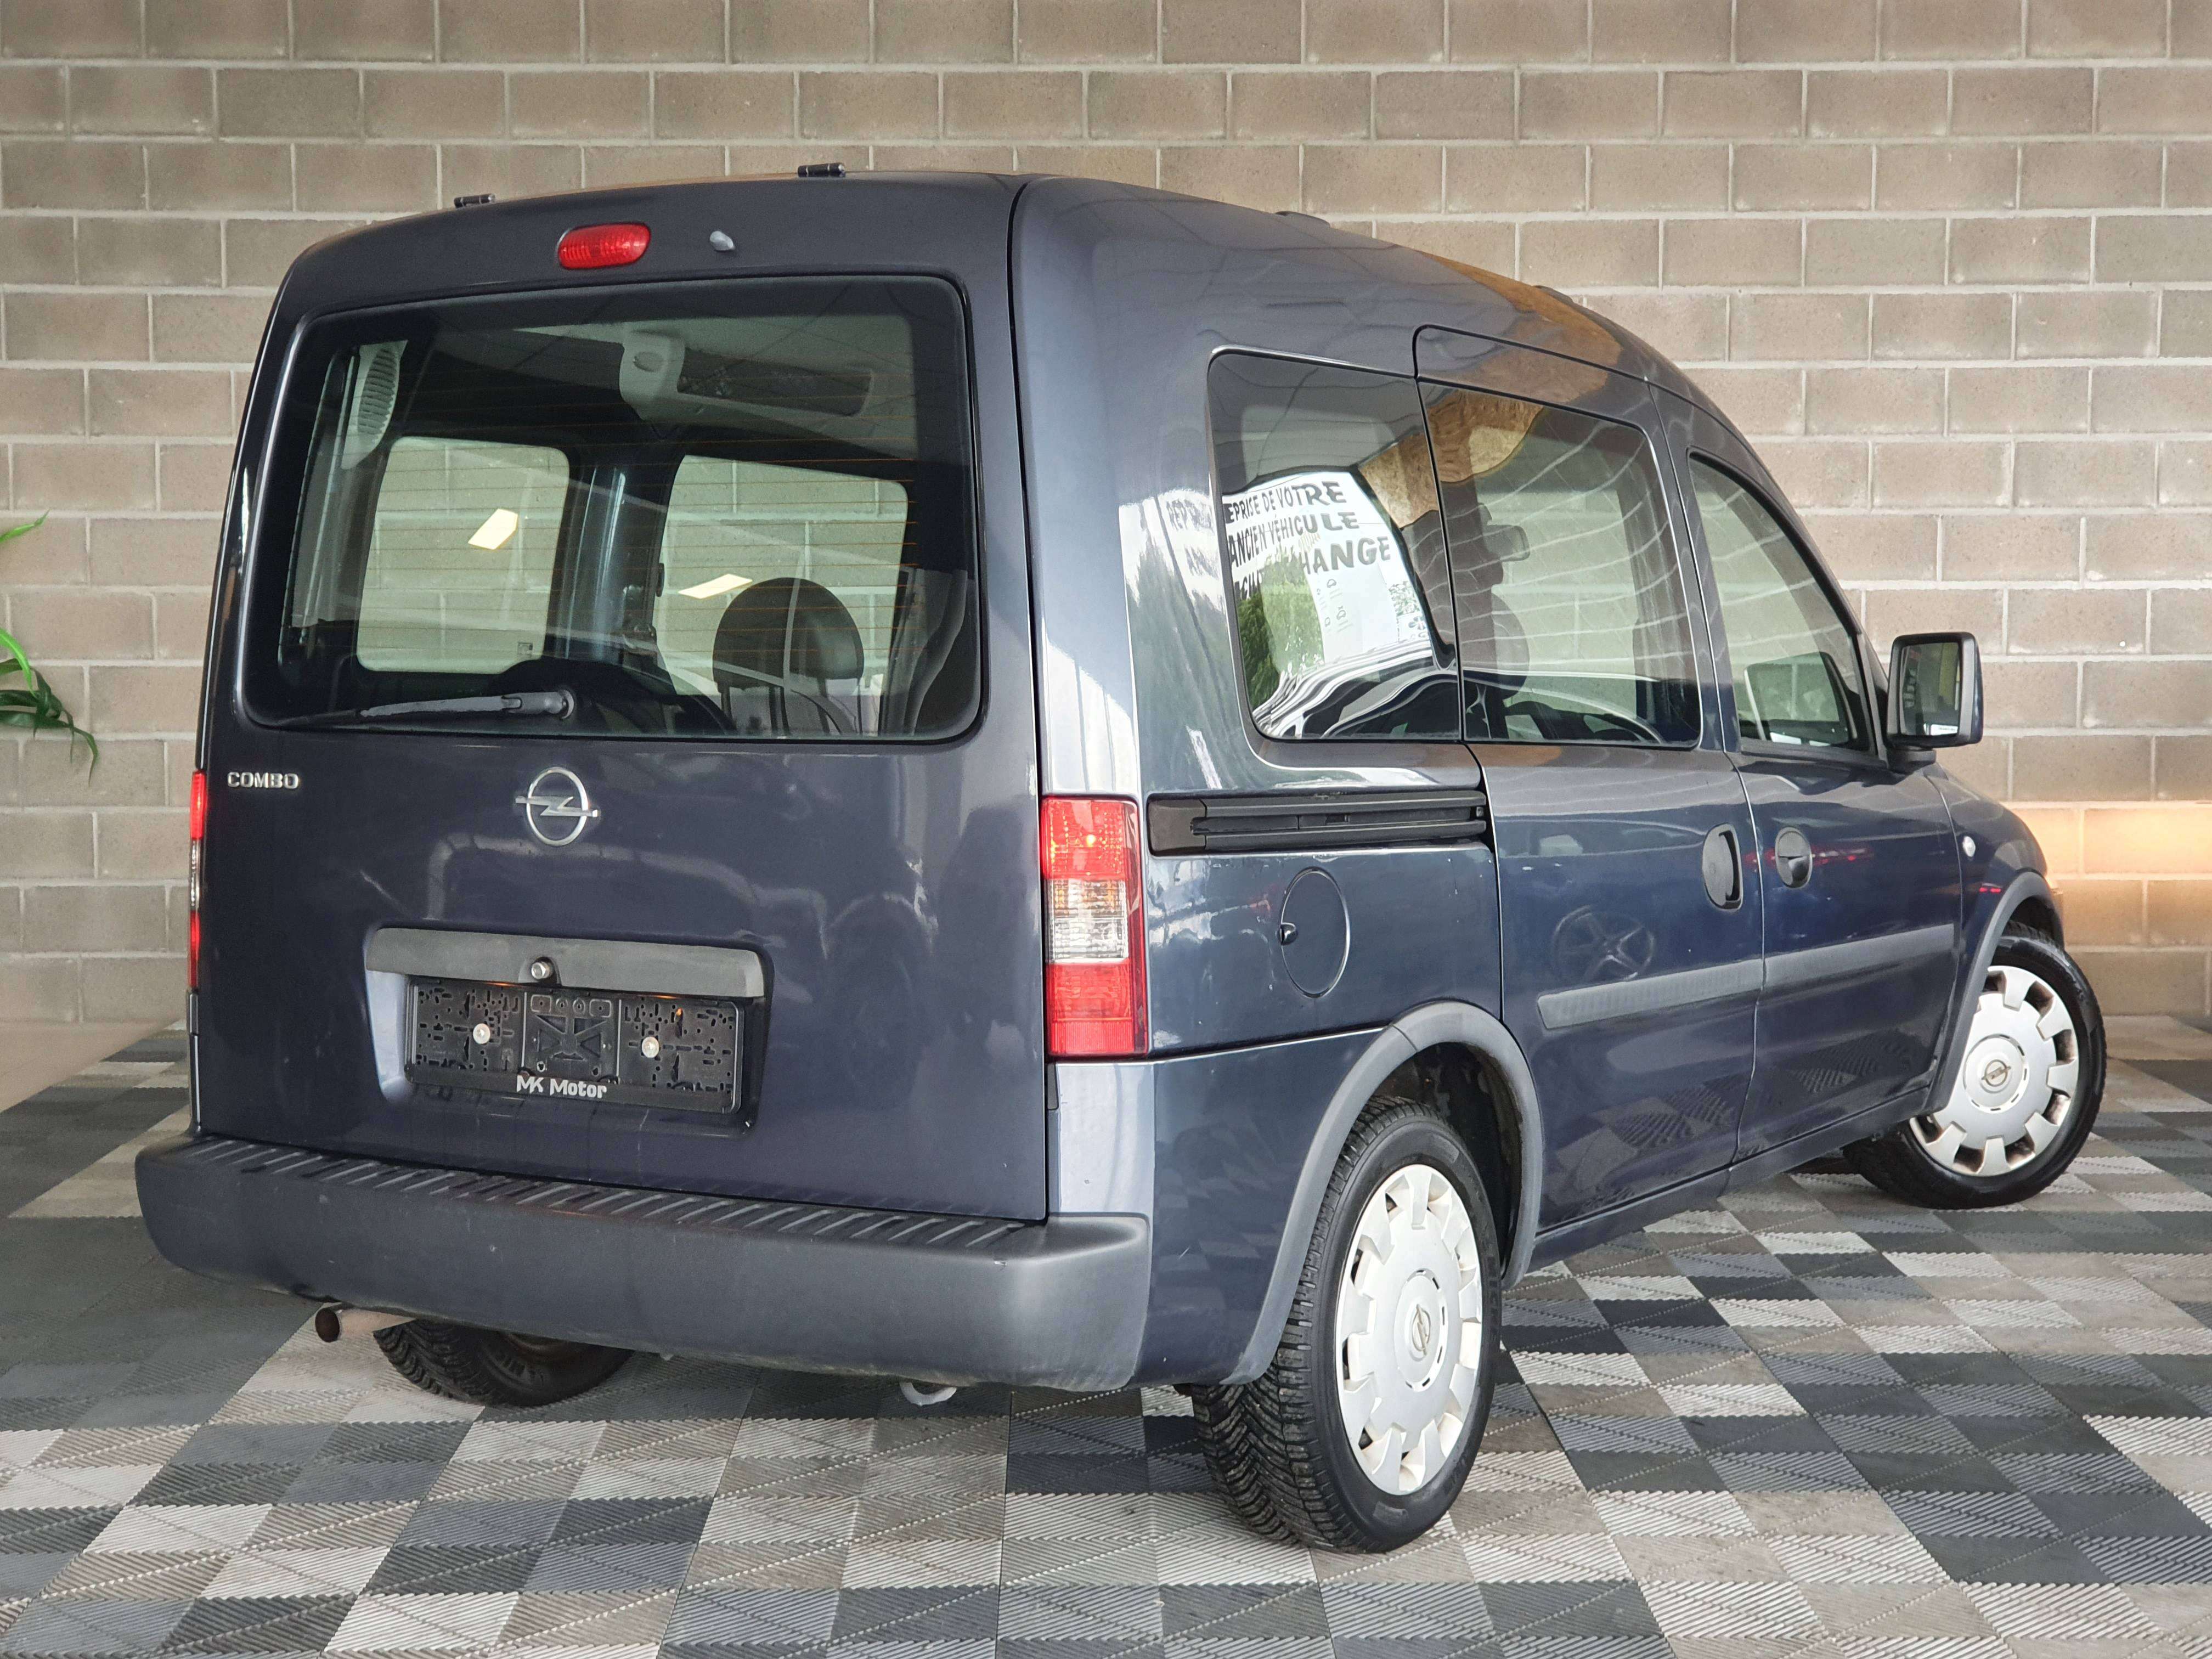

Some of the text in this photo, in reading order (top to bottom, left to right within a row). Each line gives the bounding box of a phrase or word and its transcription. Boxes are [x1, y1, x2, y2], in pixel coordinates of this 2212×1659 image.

[1262, 490, 1276, 512] DE
[1276, 481, 1347, 508] VOTRE
[227, 771, 298, 789] COMBO
[517, 1075, 607, 1098] MK Motor
